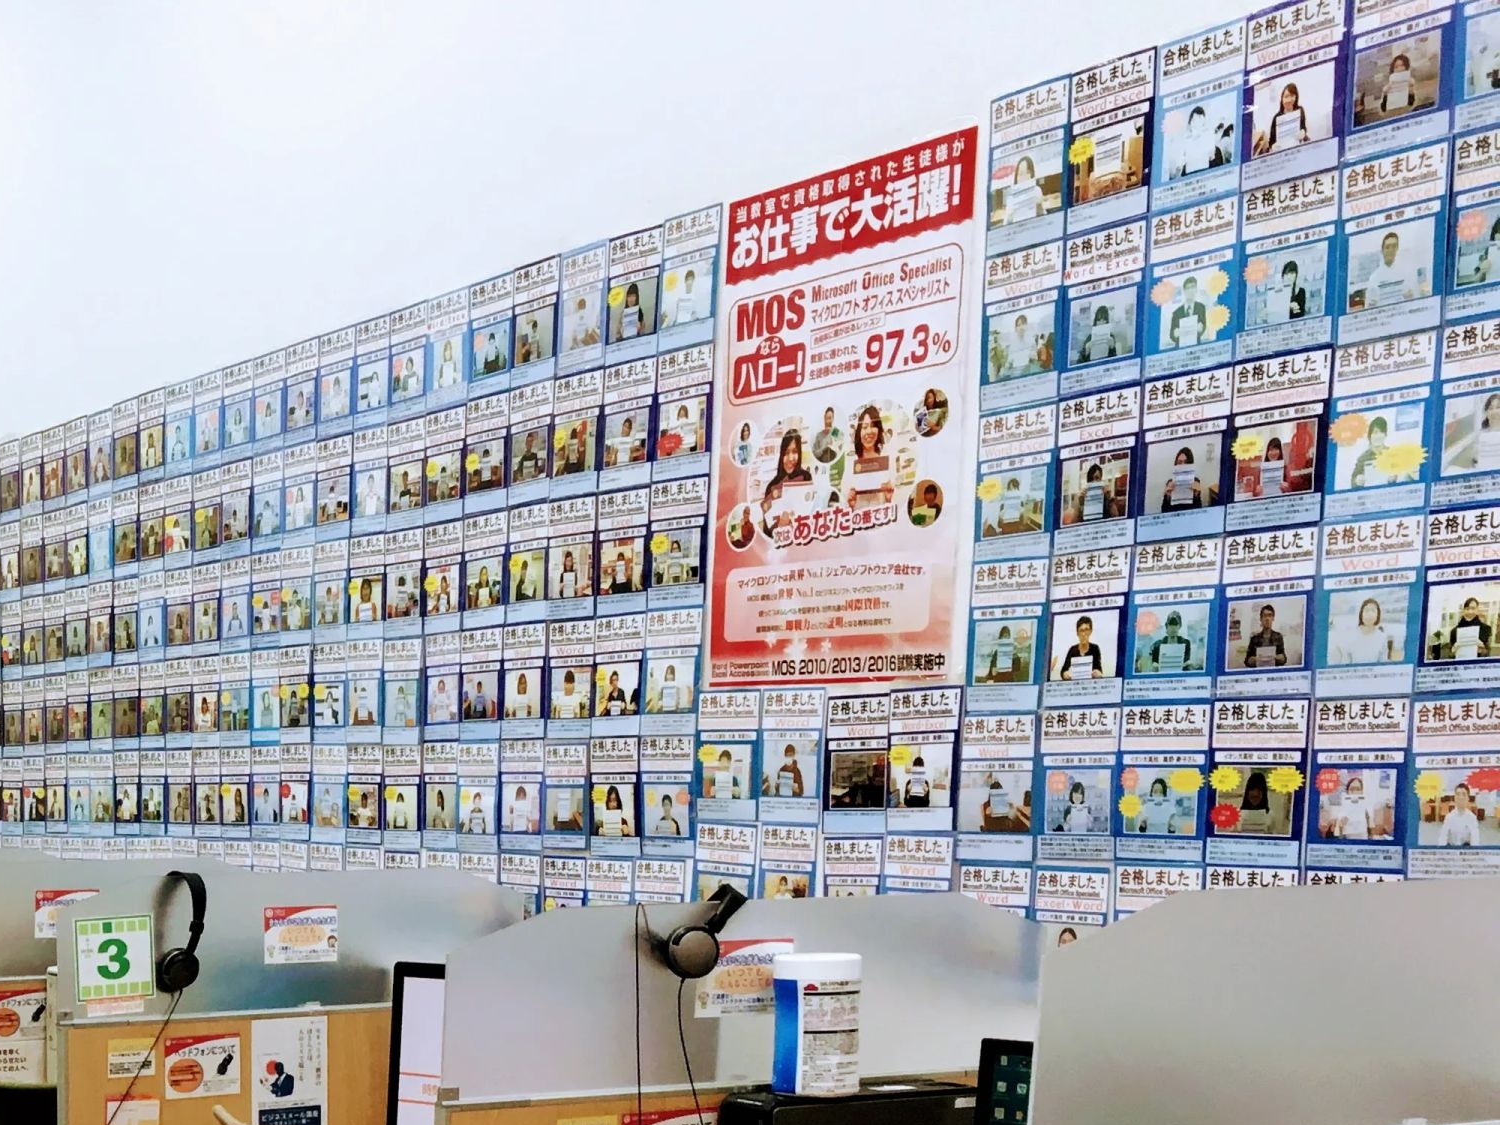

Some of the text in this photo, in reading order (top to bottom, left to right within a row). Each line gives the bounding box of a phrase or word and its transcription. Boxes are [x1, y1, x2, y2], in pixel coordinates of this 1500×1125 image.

[736, 138, 965, 223] 当教室で資格取得された生徒様が
[1245, 194, 1335, 221] Microsoft Office Specialist
[812, 256, 952, 304] Microsoft Office Specialist
[736, 288, 805, 342] MOS
[759, 337, 781, 354] なら
[865, 323, 951, 373] 97.3%
[809, 359, 860, 381] 生徒様の合格率
[1237, 372, 1321, 394] Microsoft Office Specialist
[1167, 406, 1204, 423] Excel
[1079, 423, 1114, 441] Excel
[1341, 555, 1399, 571] Word
[1069, 581, 1110, 596] Excel
[772, 659, 796, 676] MOS
[847, 726, 876, 737] Word
[1318, 721, 1401, 732] Microsoft Office Specialist
[97, 938, 131, 980] 3
[174, 1044, 236, 1057] ヘッドフォンについて
